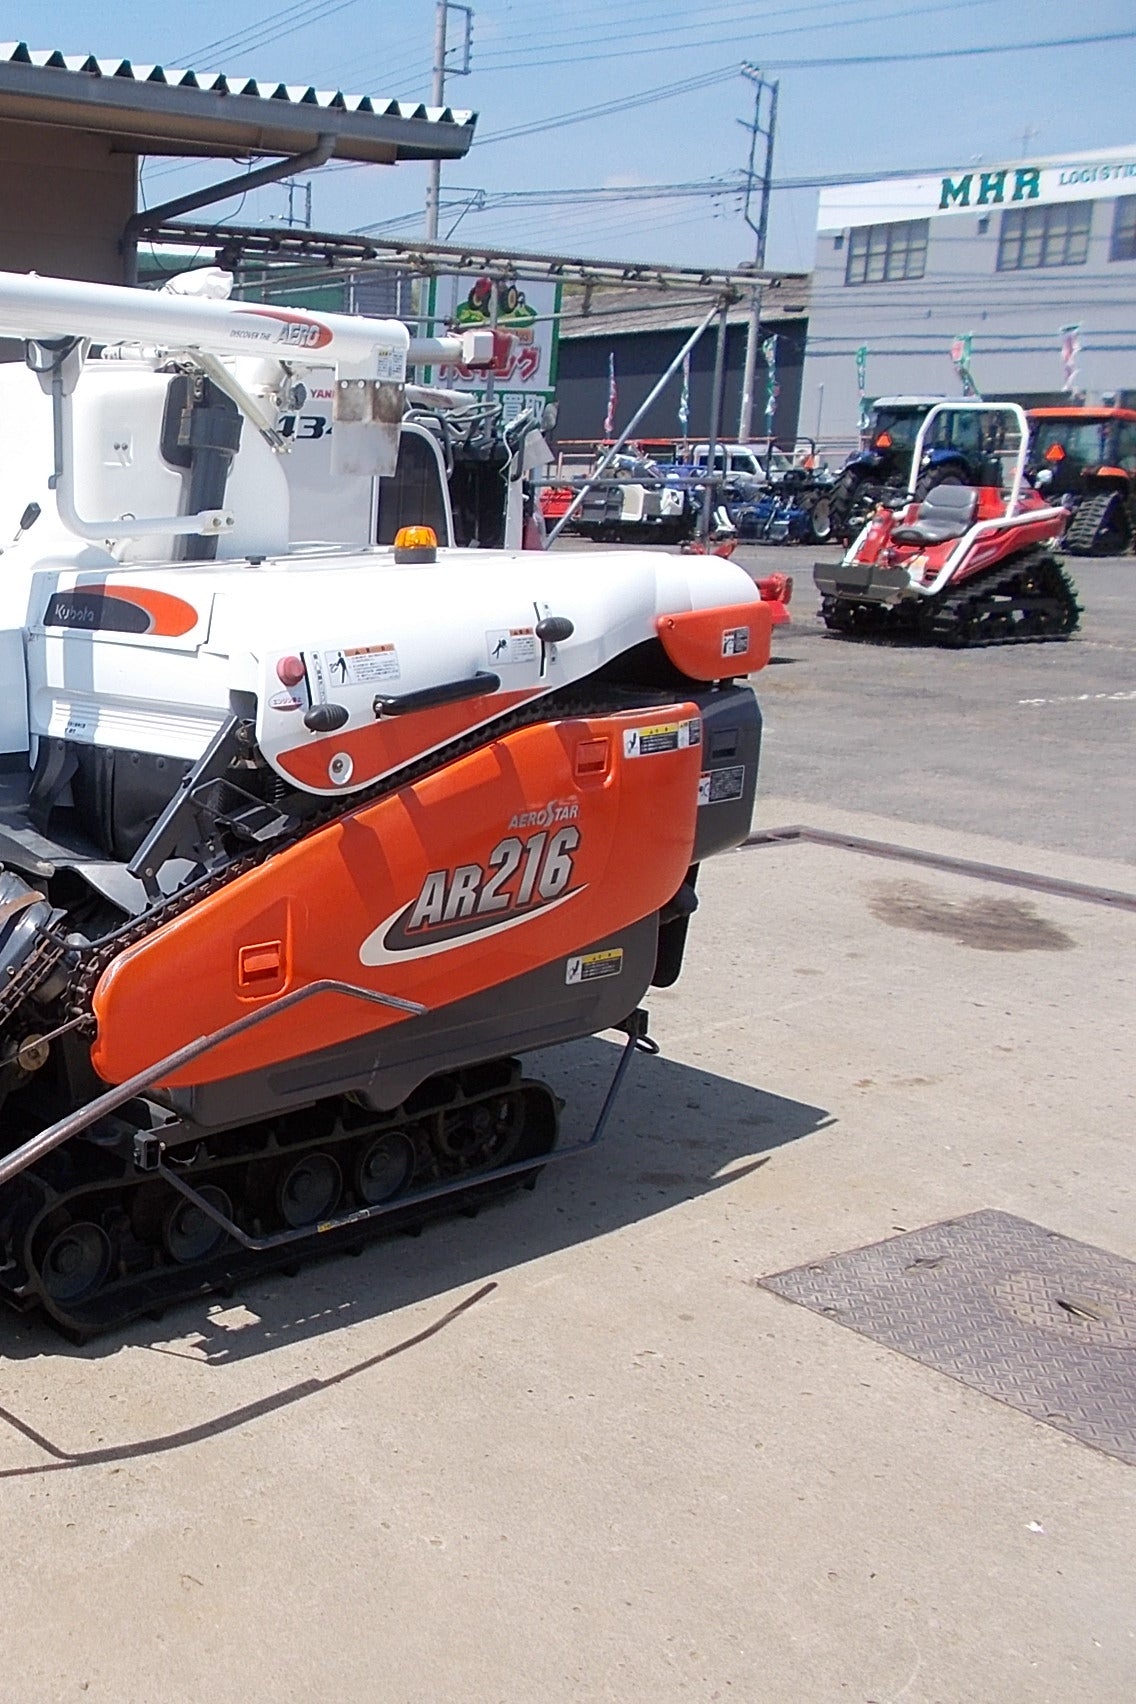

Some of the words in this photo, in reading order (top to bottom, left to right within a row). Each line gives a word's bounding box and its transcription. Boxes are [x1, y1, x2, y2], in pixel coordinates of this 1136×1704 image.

[939, 166, 1042, 209] MHR
[275, 322, 321, 347] AERO
[310, 389, 335, 399] YAN
[54, 603, 95, 622] Kubota
[407, 825, 581, 929] AR216
